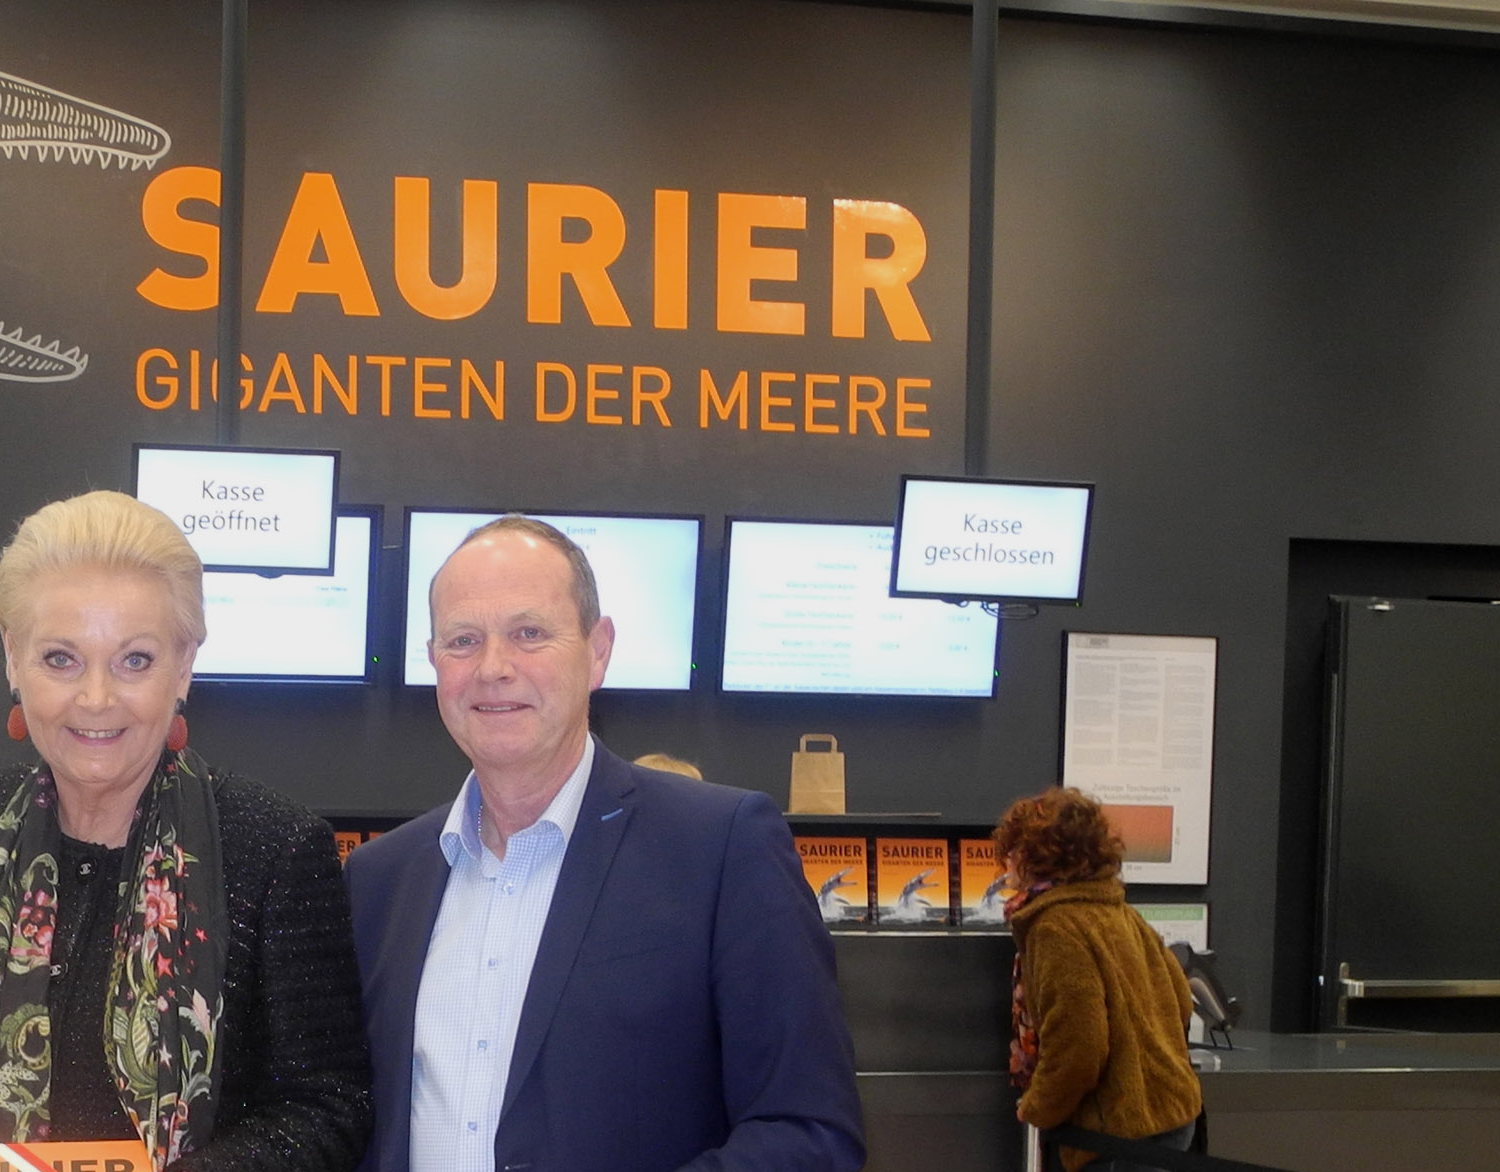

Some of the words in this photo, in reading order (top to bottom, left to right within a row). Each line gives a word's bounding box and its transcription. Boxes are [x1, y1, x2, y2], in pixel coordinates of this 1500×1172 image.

[135, 166, 932, 341] SAURIER
[135, 348, 505, 420] GIGANTEN
[536, 361, 672, 427] DER
[701, 369, 932, 438] MEERE
[202, 480, 265, 501] Kasse
[182, 509, 281, 535] geöffnet
[963, 513, 1023, 535] Kasse
[924, 542, 1054, 566] geschlossen
[800, 844, 862, 857] SAURIER
[882, 845, 943, 858] SAURIER
[966, 847, 994, 859] SAU
